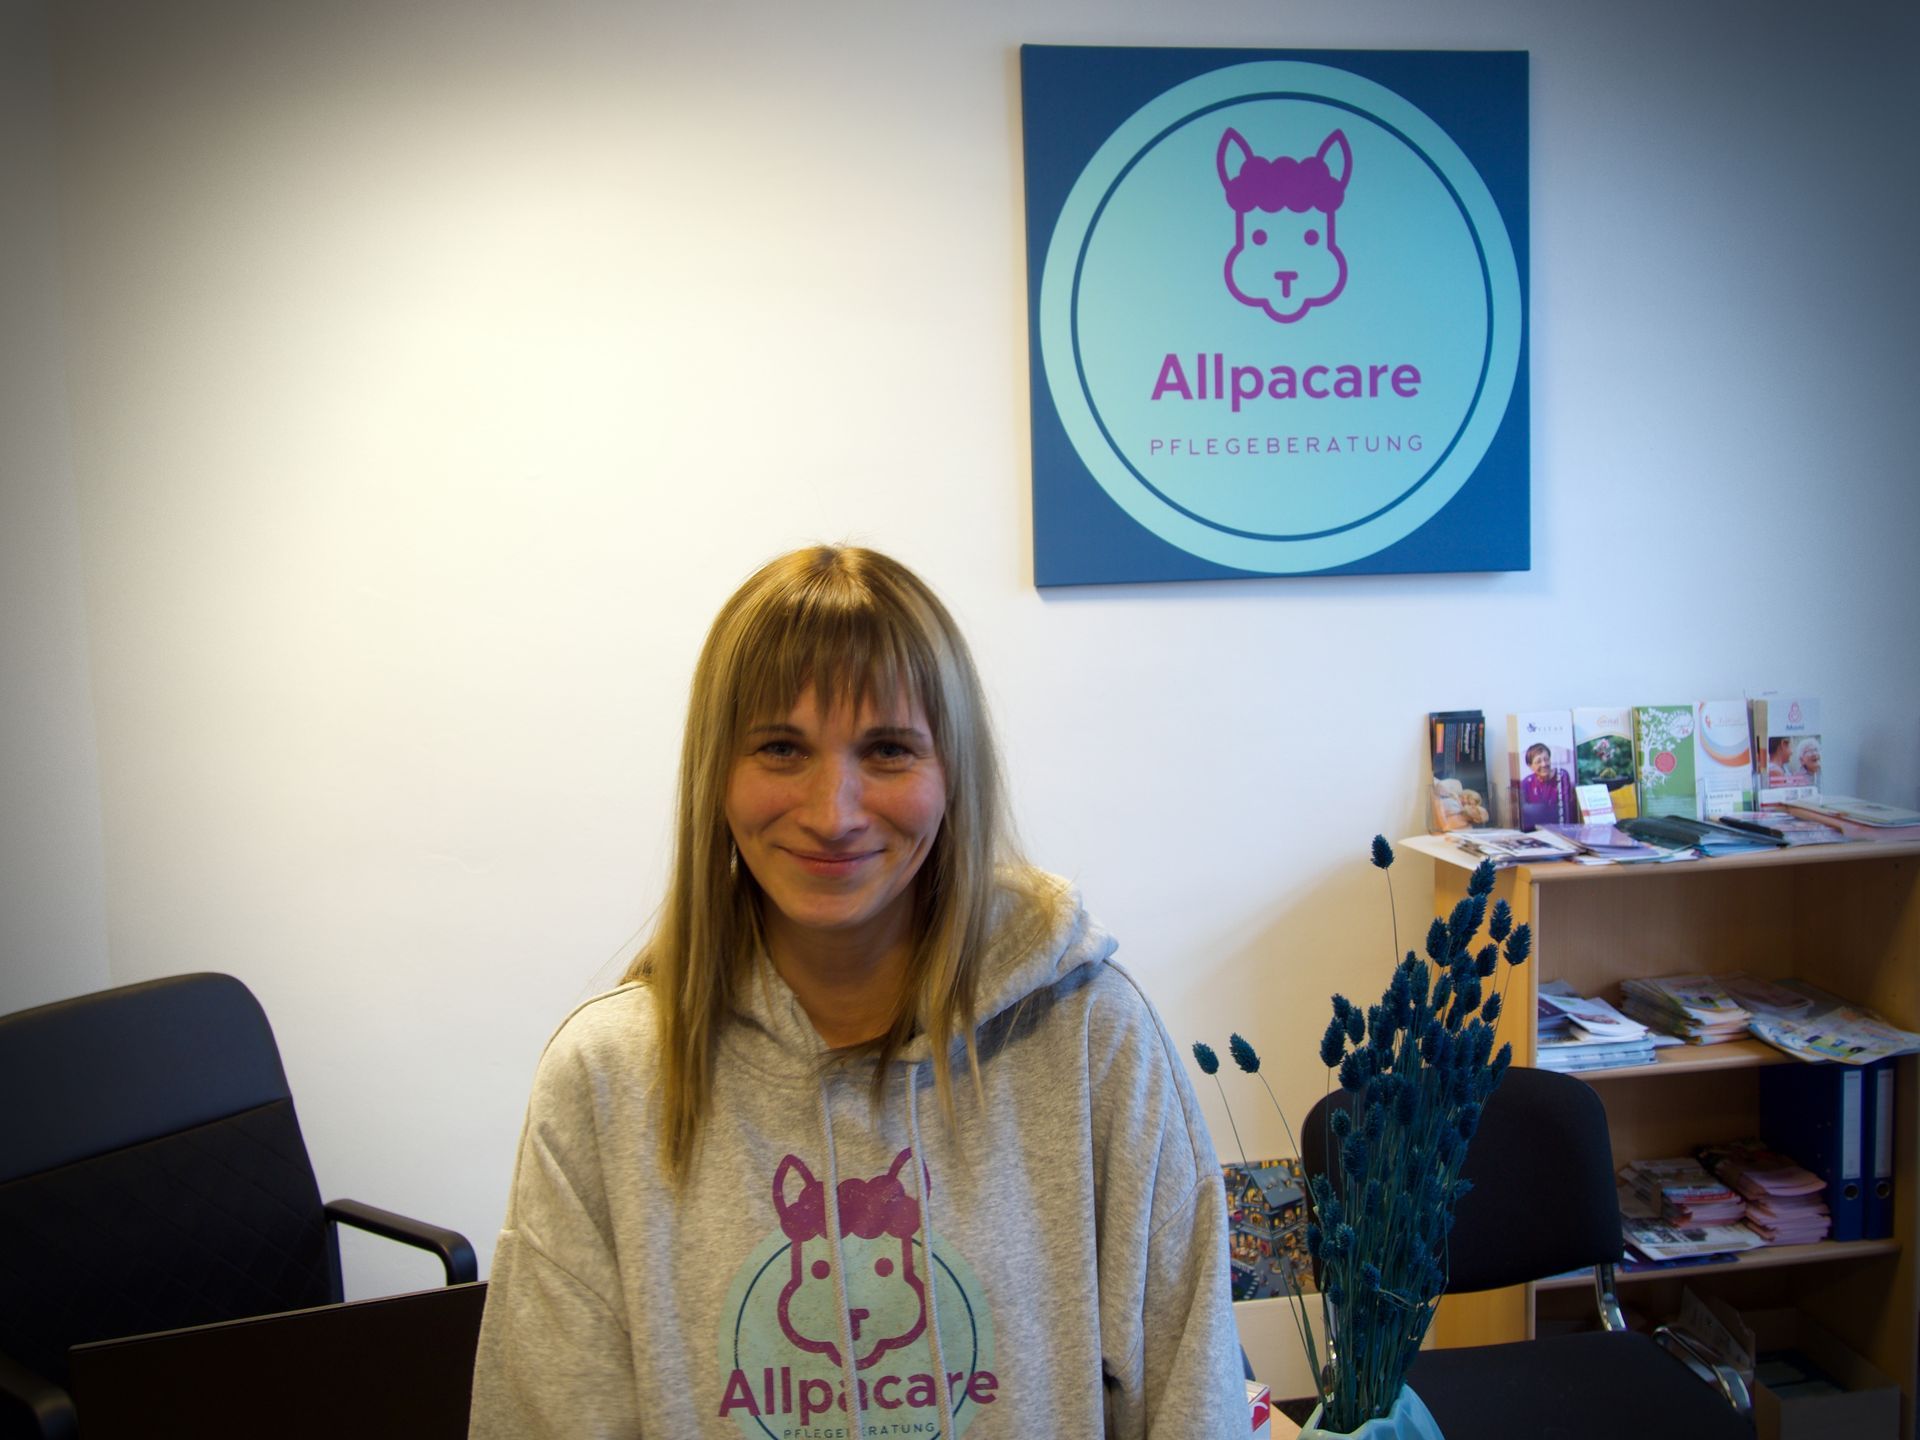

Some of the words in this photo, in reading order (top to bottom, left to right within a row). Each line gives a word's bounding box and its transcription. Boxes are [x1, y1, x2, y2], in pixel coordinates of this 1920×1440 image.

[1151, 352, 1422, 413] Allpacare
[1150, 434, 1424, 456] PFLEGEBERATUNG
[783, 1422, 935, 1439] PFLEGERATUNG
